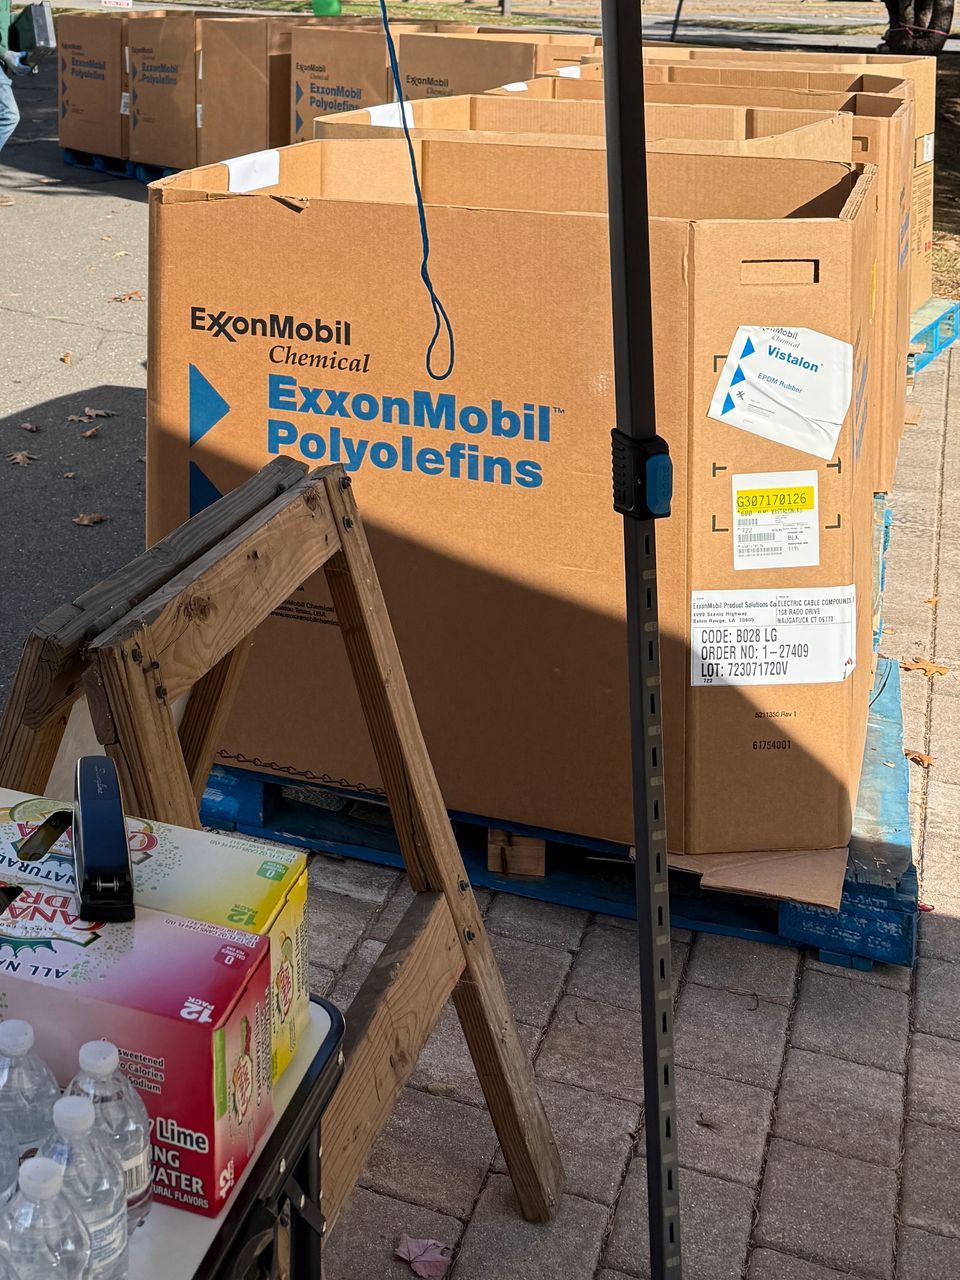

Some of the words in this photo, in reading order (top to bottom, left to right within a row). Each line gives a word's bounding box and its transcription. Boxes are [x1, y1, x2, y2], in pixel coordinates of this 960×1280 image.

[296, 62, 326, 72] ExxonMobil
[406, 75, 448, 88] ExxonMobil
[310, 83, 362, 99] ExxonMobil
[190, 306, 351, 346] ExxonMobil
[268, 345, 370, 373] Chemical
[767, 345, 819, 373] Vistalon
[758, 372, 778, 384] EPDM
[780, 380, 803, 394] Rubber
[267, 373, 550, 443] ExxonMobil
[267, 418, 543, 489] Polyolefins
[737, 493, 807, 508] G307170126
[777, 599, 802, 607] ELECTRIC
[804, 599, 820, 607] CABLE
[701, 629, 732, 644] CODE:
[736, 628, 761, 643] B028
[764, 628, 777, 643] LG
[701, 646, 736, 661] ORDER
[740, 645, 758, 660] NO:
[701, 663, 724, 678] LOT:
[728, 661, 788, 677] 723071720V
[752, 740, 791, 750] 61754001
[15, 890, 72, 910] DR
[227, 909, 258, 927] 12
[224, 956, 235, 965] 0
[29, 964, 69, 979] ALL
[187, 996, 215, 1010] PACK
[180, 1001, 213, 1024] 12
[118, 1049, 164, 1068] sweetened
[128, 1063, 164, 1081] Calories
[129, 1075, 161, 1093] Sodium
[158, 1118, 207, 1152] Lime
[174, 1191, 209, 1209] FLAVORS
